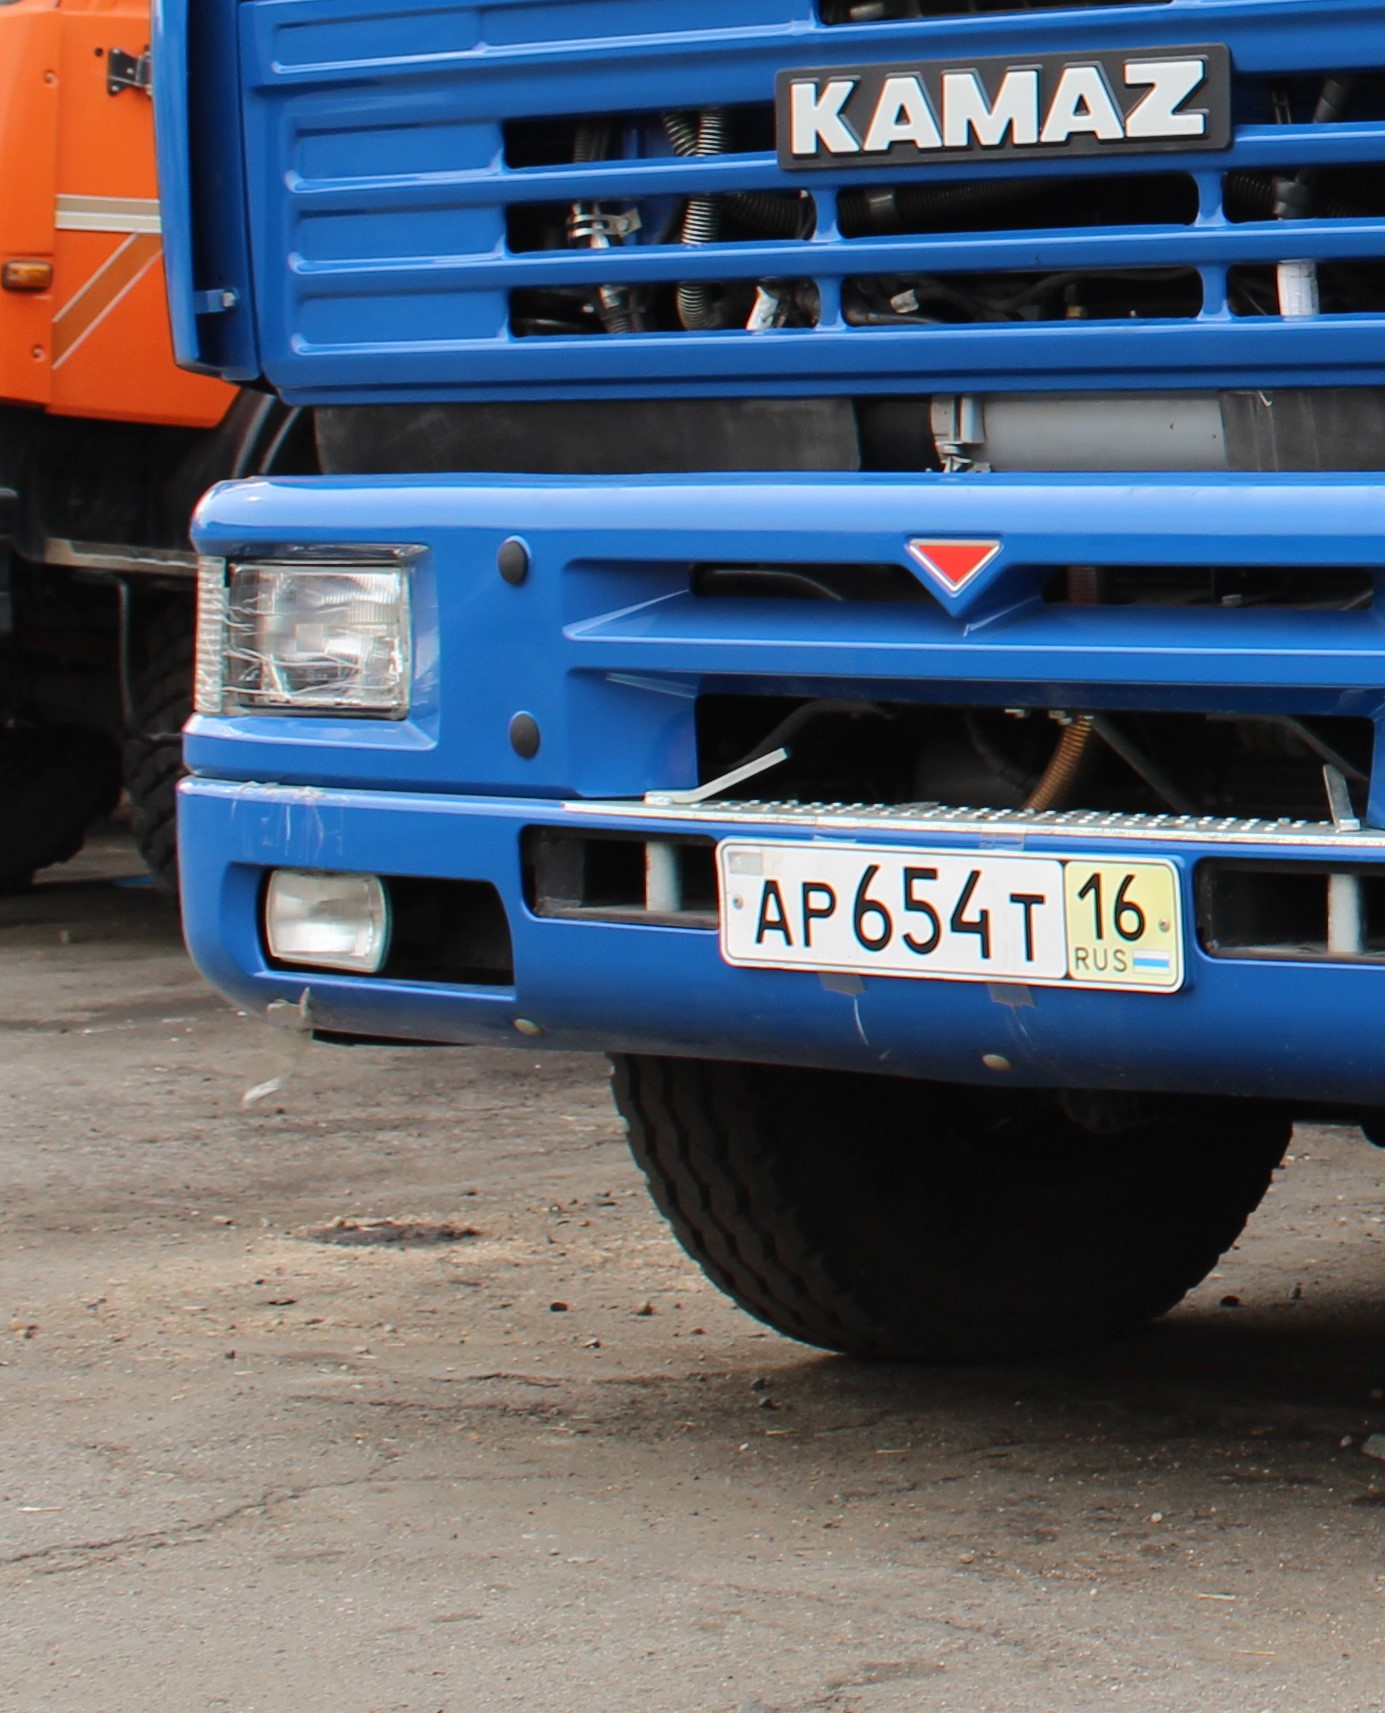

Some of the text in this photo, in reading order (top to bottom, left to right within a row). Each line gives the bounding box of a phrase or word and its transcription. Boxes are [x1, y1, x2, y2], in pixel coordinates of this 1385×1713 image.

[790, 58, 1207, 155] KAMAZ
[1077, 872, 1146, 942] 16
[1075, 947, 1128, 972] RUS
